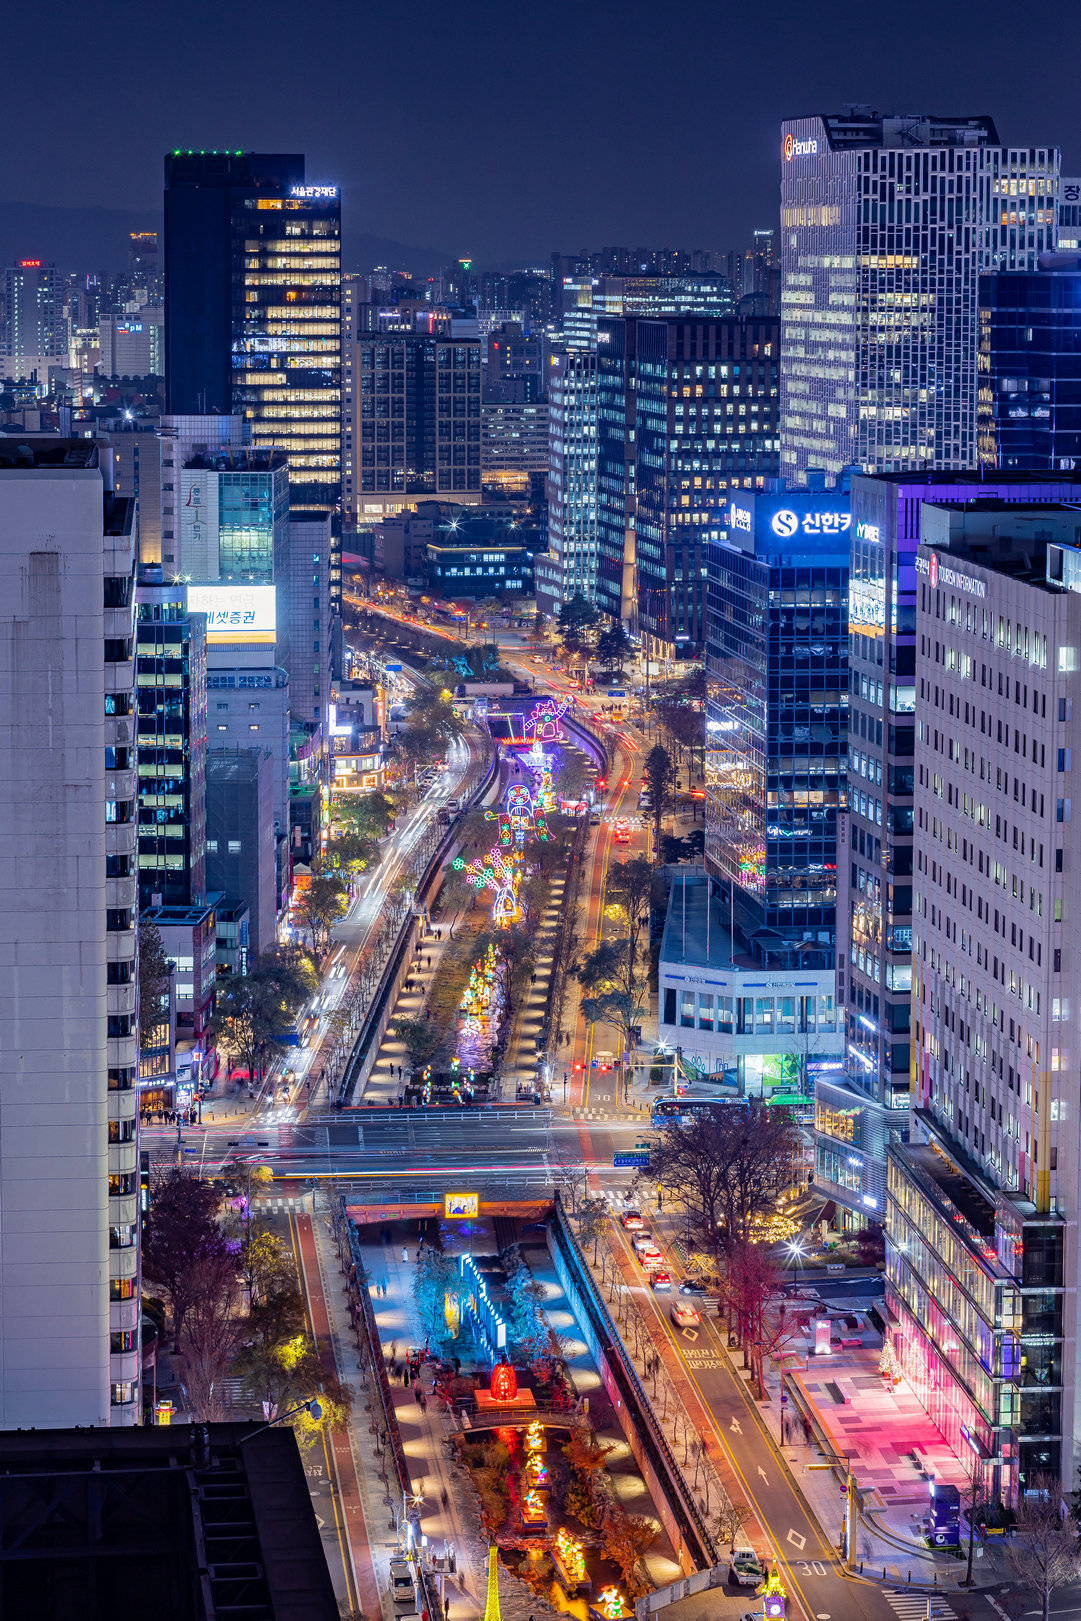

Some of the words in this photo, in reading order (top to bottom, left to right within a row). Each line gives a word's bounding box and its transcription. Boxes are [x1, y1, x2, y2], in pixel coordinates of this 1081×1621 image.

[792, 137, 817, 155] Hanwha
[938, 565, 956, 586] TOURISM
[956, 572, 985, 598] INFORMATION
[796, 1561, 827, 1576] 30
